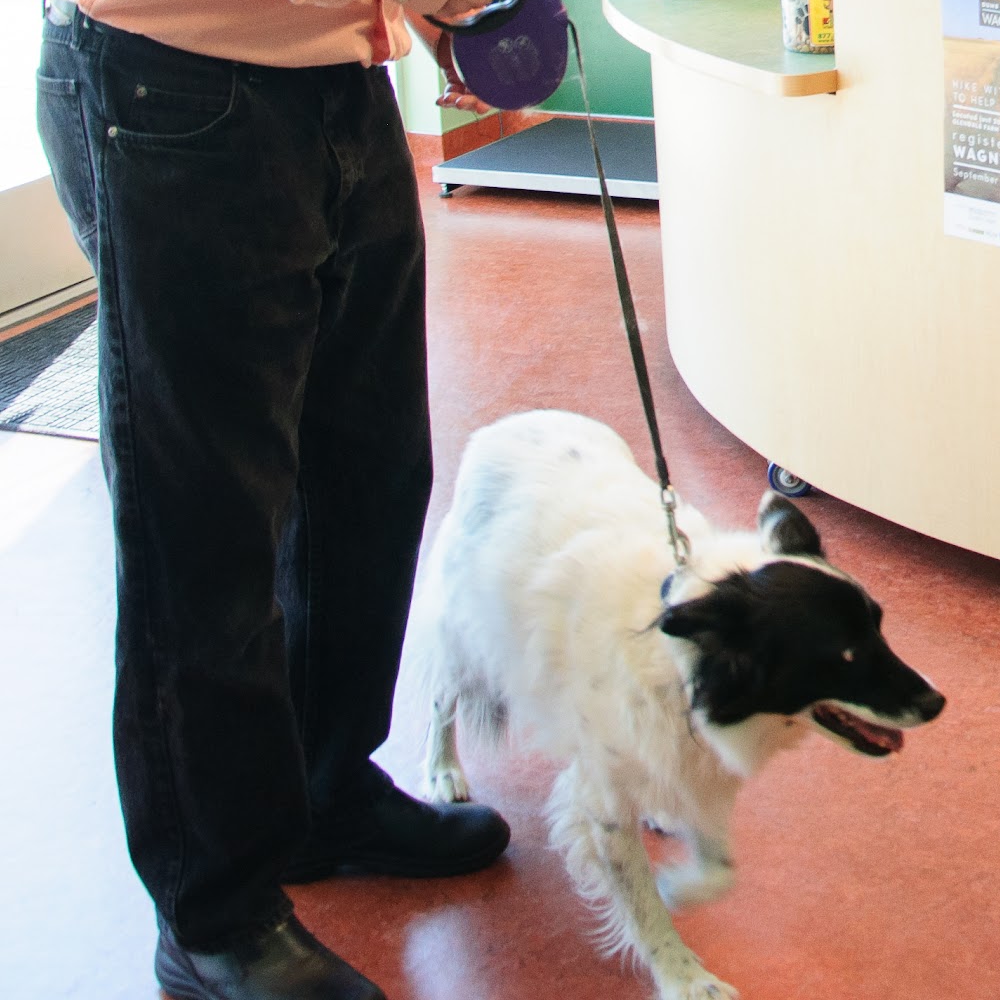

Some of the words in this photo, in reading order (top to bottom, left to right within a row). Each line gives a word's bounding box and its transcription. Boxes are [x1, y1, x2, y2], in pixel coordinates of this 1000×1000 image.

[952, 80, 977, 92] HIKE
[952, 92, 966, 103] TO
[970, 95, 996, 107] HELP
[952, 167, 999, 184] September
